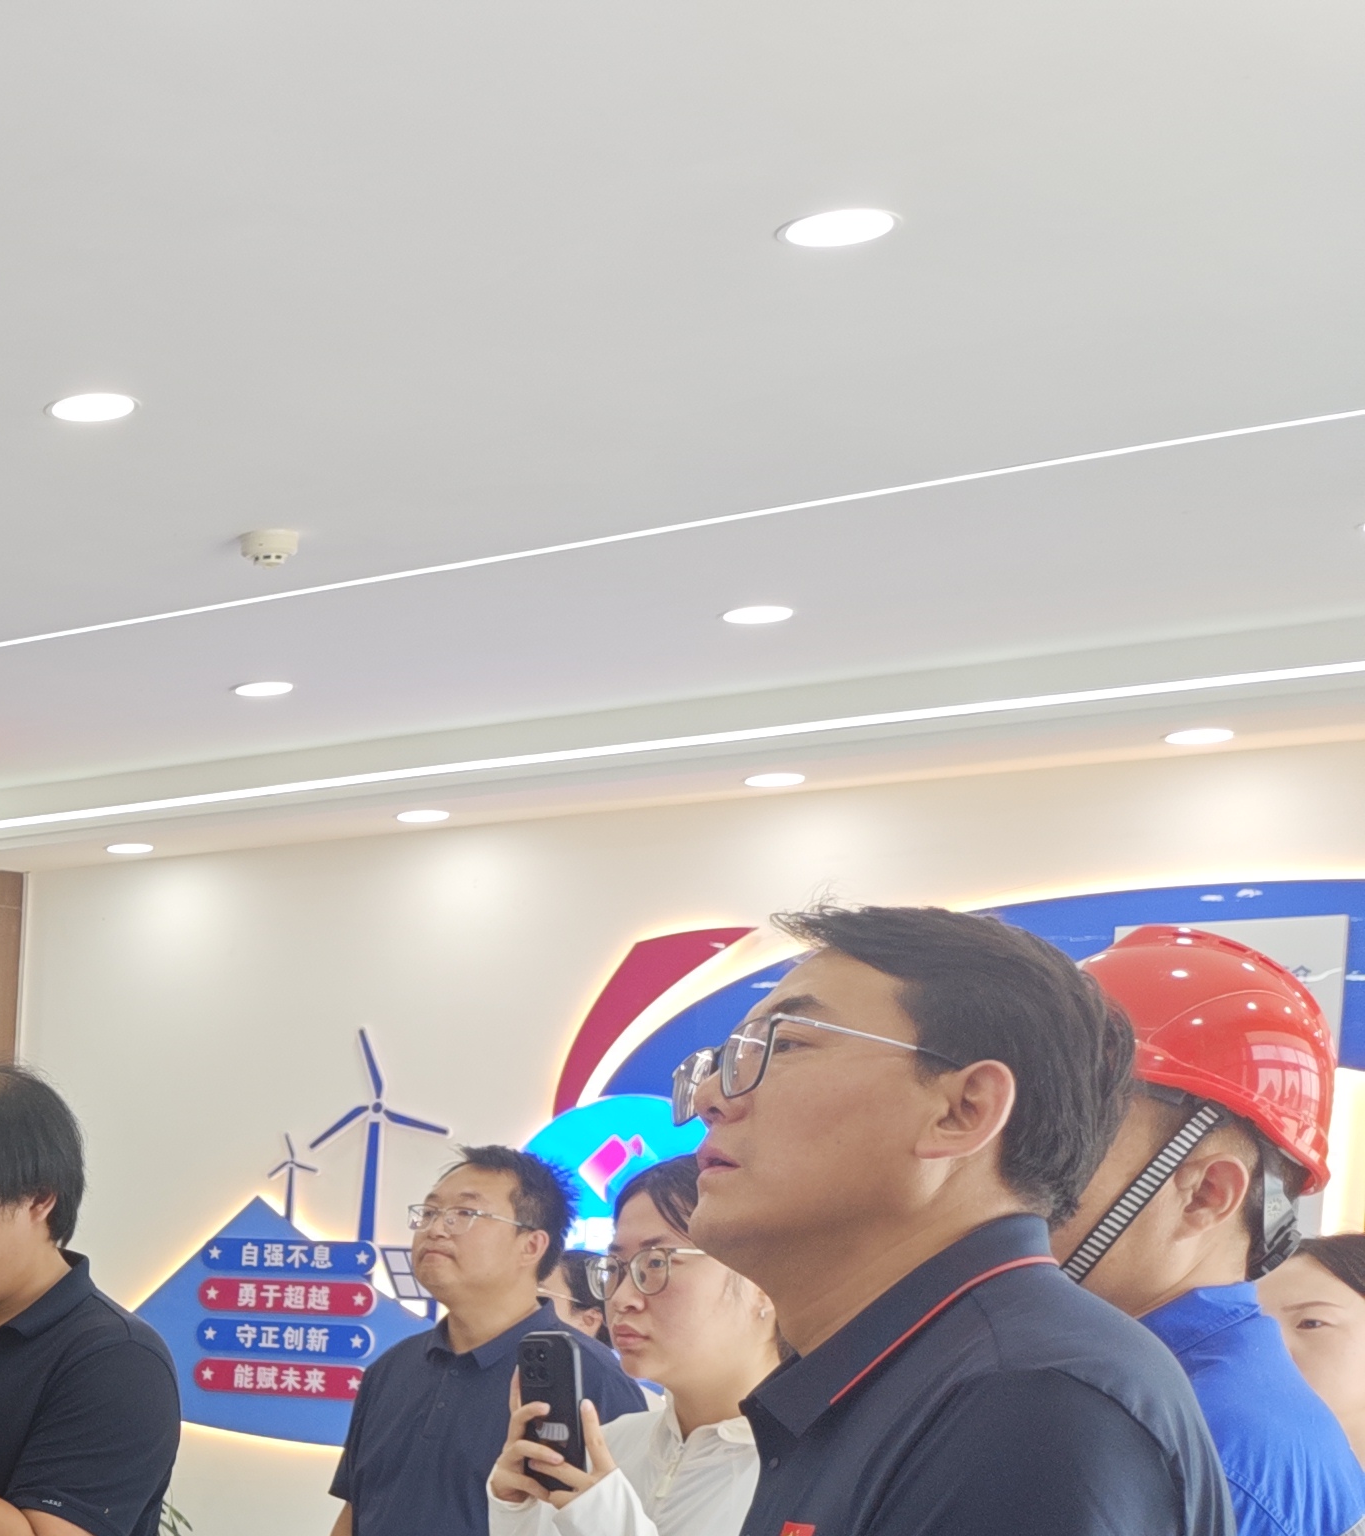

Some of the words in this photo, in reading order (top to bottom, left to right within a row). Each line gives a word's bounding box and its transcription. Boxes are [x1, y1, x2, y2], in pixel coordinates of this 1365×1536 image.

[240, 1241, 333, 1269] 自强不息
[237, 1282, 331, 1311] 勇于超越
[235, 1323, 329, 1353] 守正创新
[233, 1363, 326, 1393] 能赋未来
